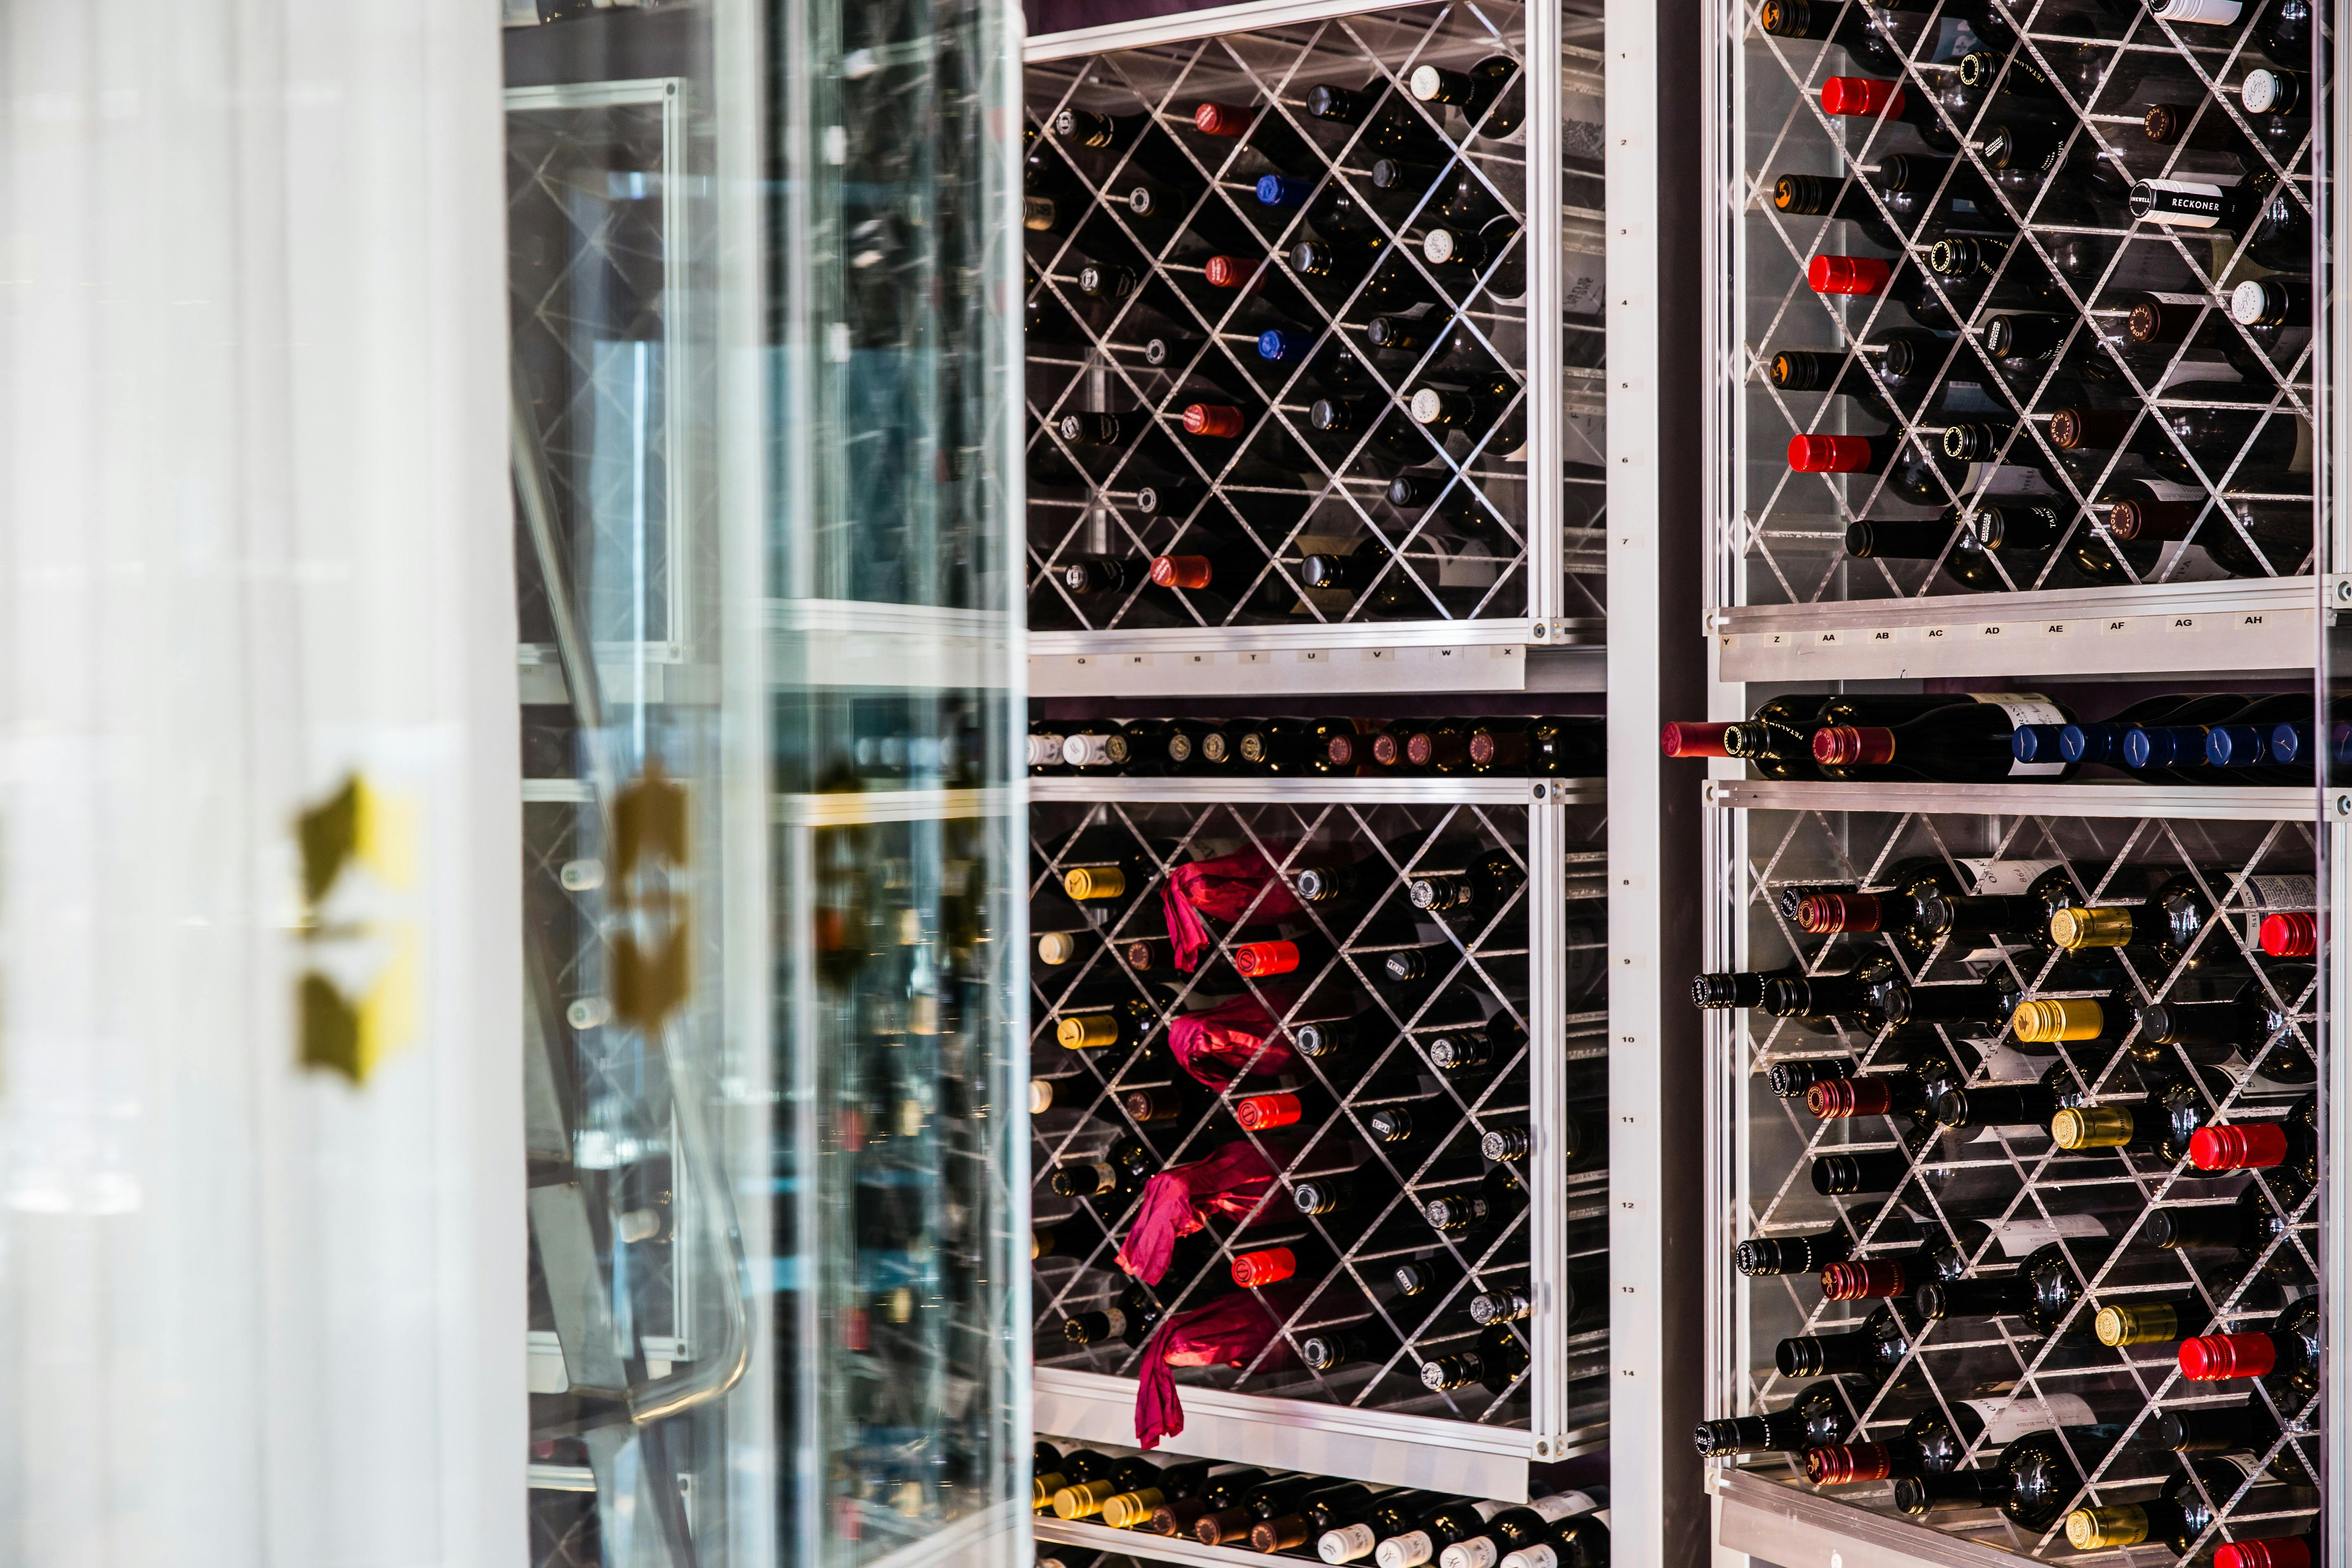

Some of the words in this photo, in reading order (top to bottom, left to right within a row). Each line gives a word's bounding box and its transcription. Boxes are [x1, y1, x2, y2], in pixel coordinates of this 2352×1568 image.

[2014, 58, 2045, 83] PETALUM
[2145, 109, 2160, 136] BAROSSA
[2153, 112, 2165, 137] VALLEY
[2172, 198, 2219, 211] RECKONER
[2130, 320, 2148, 337] BAROSSA
[2052, 414, 2063, 442] BAROSSA
[2111, 505, 2123, 535] BAROSSA
[2110, 622, 2125, 630] AF
[2244, 616, 2262, 624] AH
[2013, 869, 2028, 883] 864
